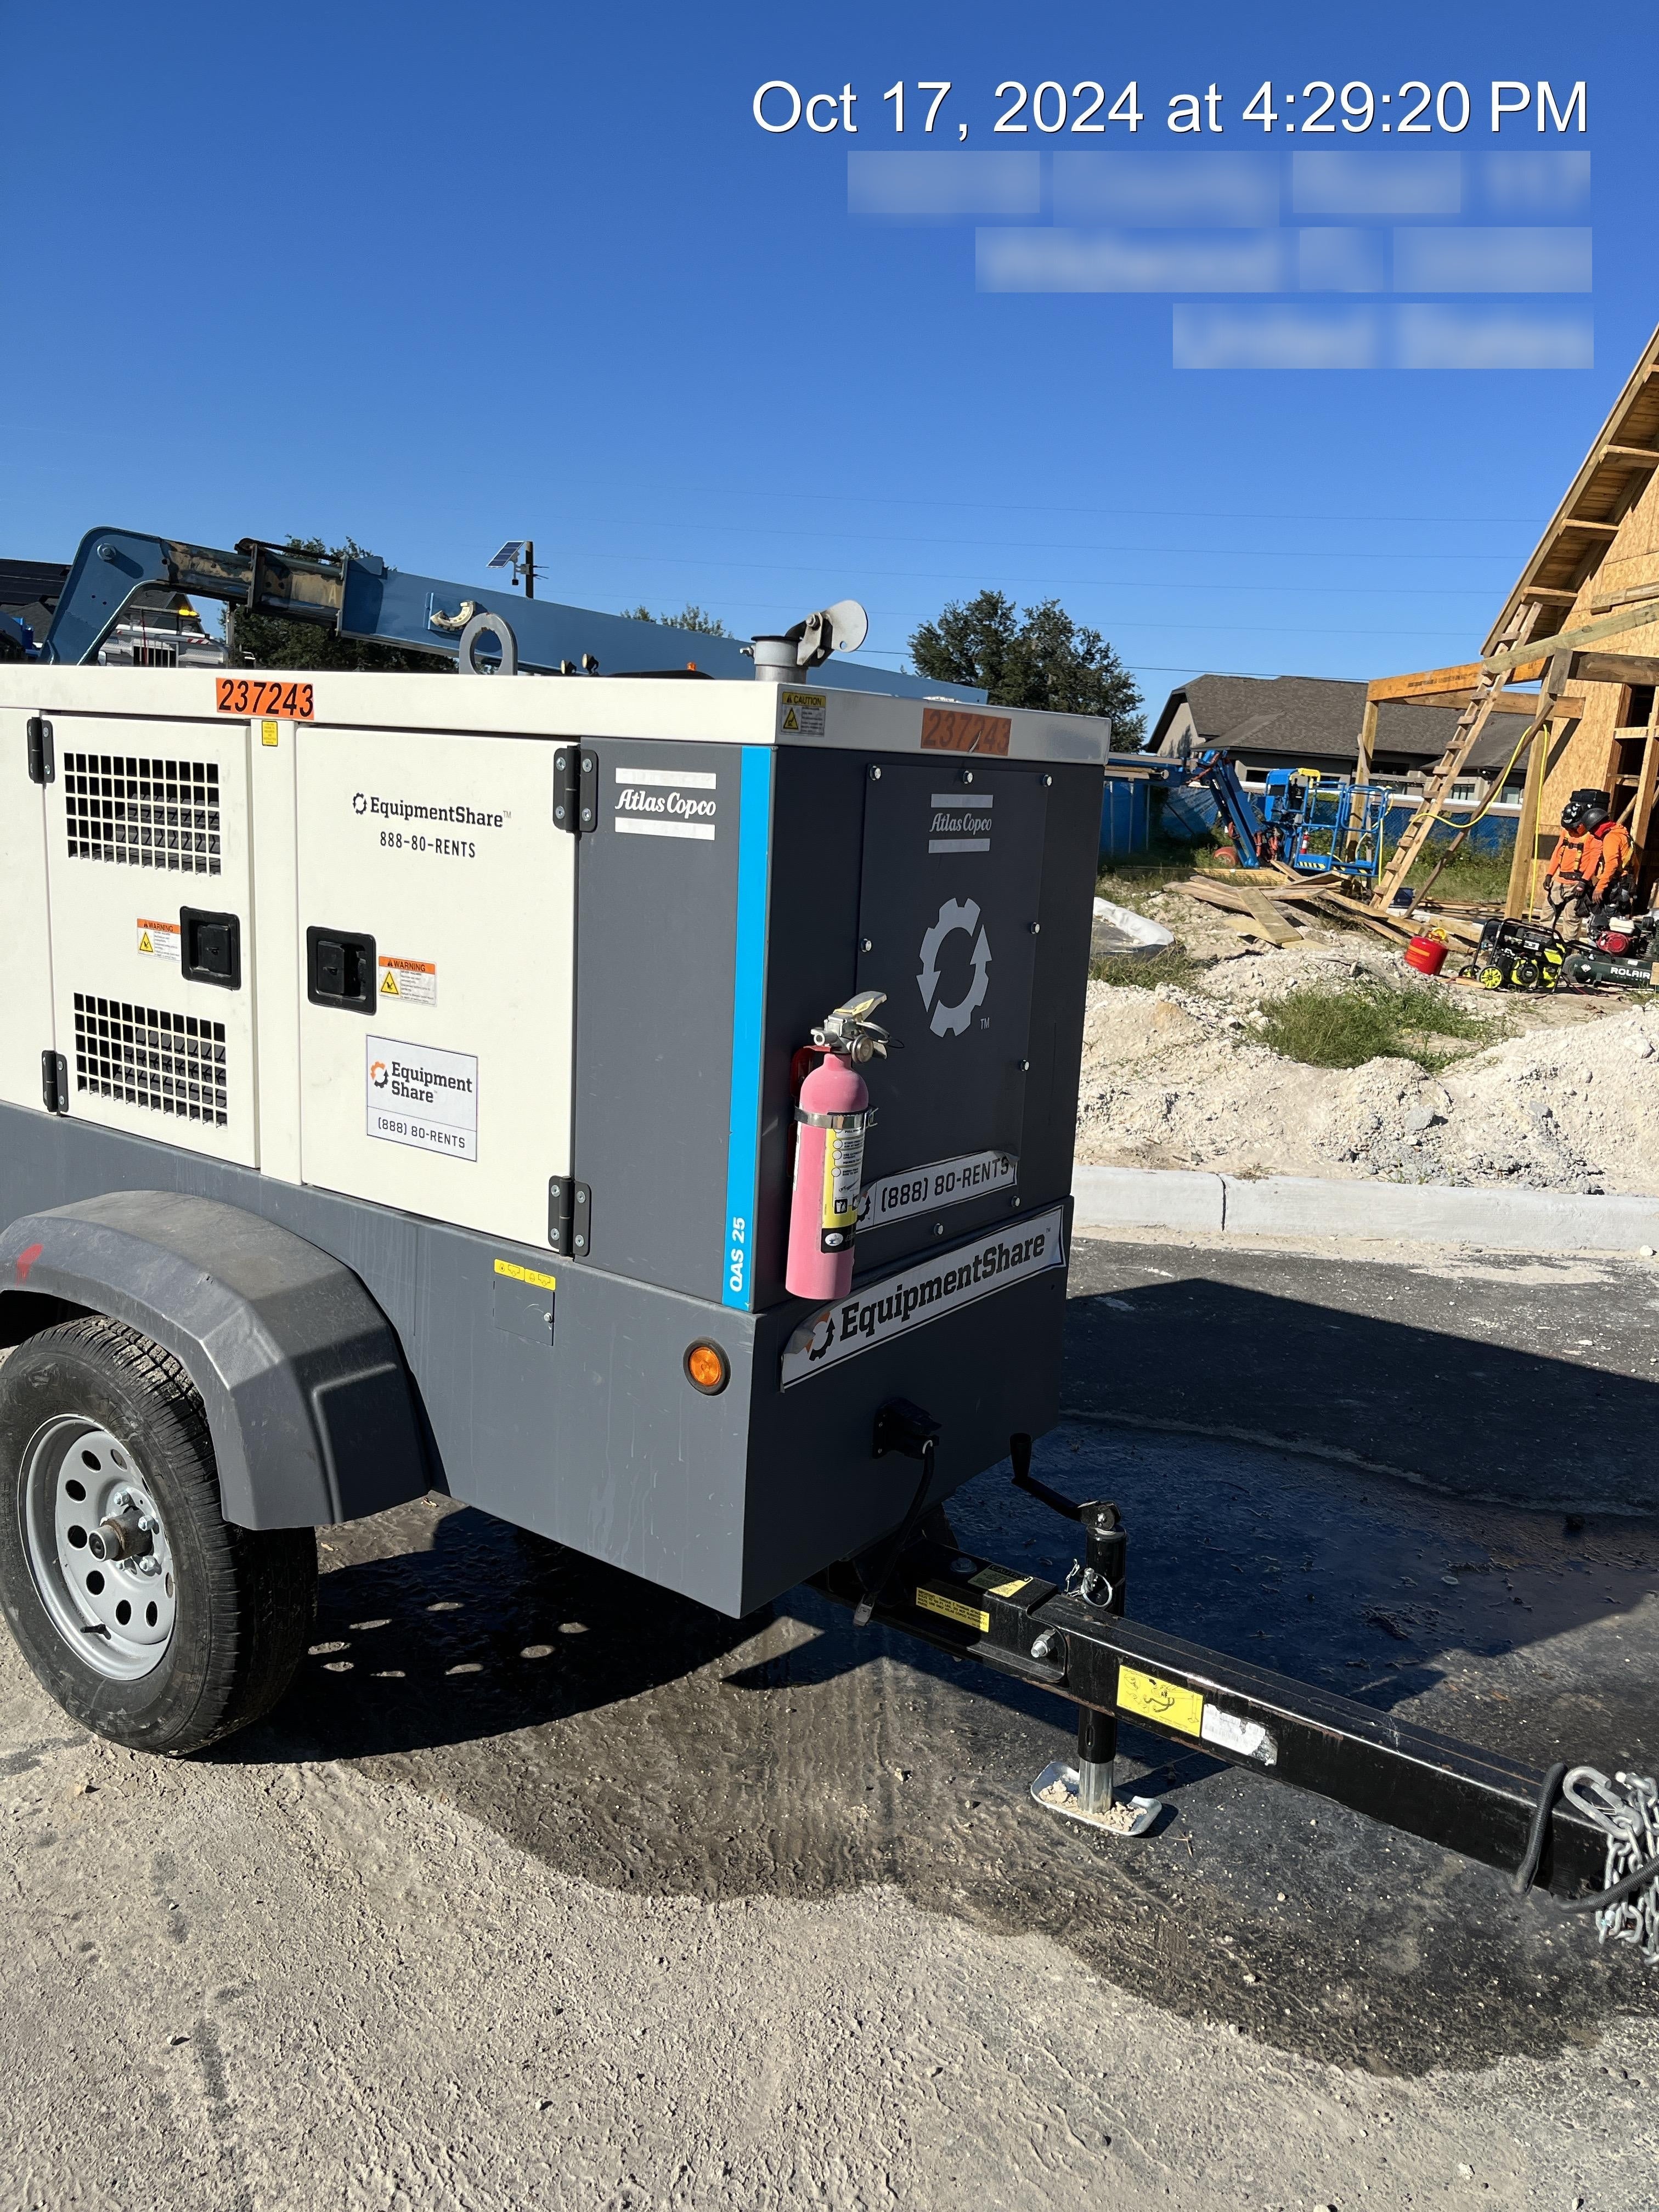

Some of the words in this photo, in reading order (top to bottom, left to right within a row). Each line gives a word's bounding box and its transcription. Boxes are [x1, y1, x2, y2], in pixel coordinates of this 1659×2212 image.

[218, 679, 313, 718] 237243
[793, 695, 822, 706] CAUTION
[923, 710, 1011, 753] 237243
[370, 797, 503, 828] EquipmentShare
[614, 788, 666, 813] Atlas
[667, 792, 716, 819] Copco
[929, 812, 963, 832] Atlas
[963, 812, 992, 836] Copco
[380, 831, 476, 859] 888-80-RENTS
[148, 922, 174, 932] WARNING
[393, 960, 426, 972] WARNING
[1610, 967, 1651, 979] ROLAIR
[391, 1061, 473, 1093] Equipment
[391, 1080, 434, 1103] Share
[378, 1116, 407, 1136] (888)
[411, 1126, 465, 1149] 80-RENTS
[881, 1177, 928, 1212] (888)
[934, 1155, 1009, 1197] 80-RENTS
[732, 1216, 746, 1244] 25
[729, 1248, 744, 1293] QAS
[839, 1233, 1045, 1342] EquipmentShare
[991, 1565, 1030, 1582] CAUTION
